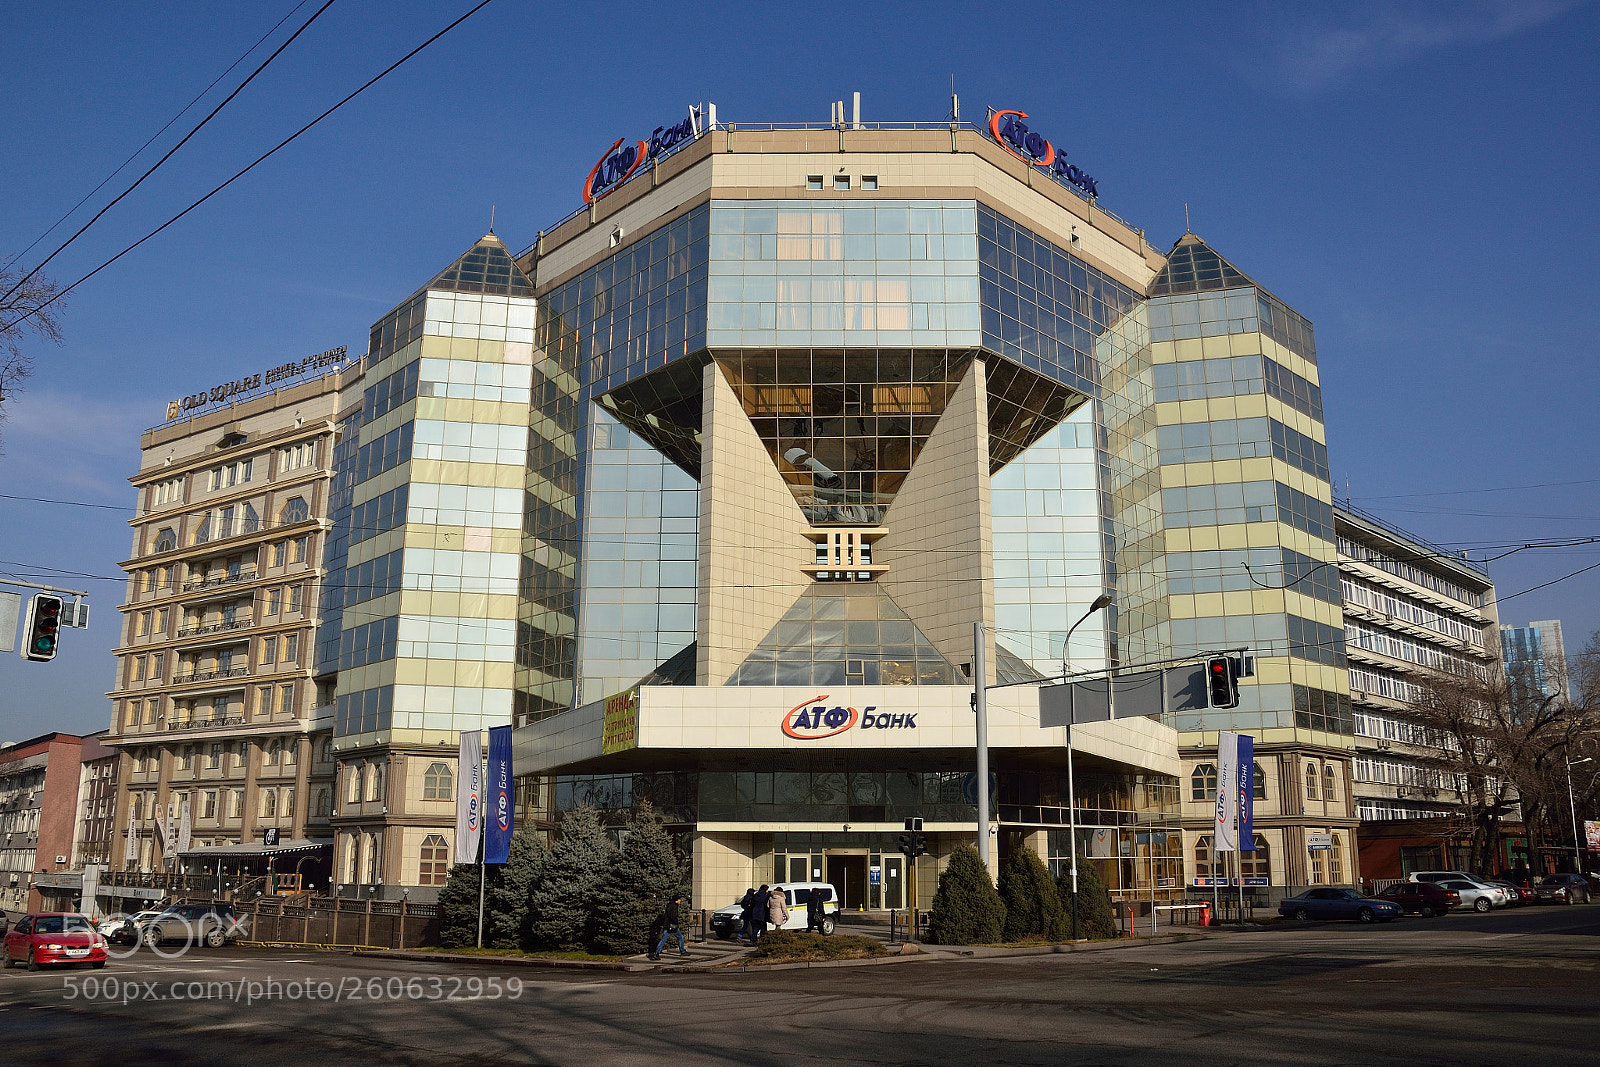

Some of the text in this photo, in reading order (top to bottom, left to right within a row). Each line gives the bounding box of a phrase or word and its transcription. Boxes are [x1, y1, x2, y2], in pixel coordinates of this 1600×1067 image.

[591, 146, 638, 194] АТФ
[999, 115, 1098, 197] АТФ Банк
[312, 353, 347, 369] CENTER
[182, 373, 262, 410] OLD SQUARE
[792, 706, 918, 729] АТФ Банк
[499, 761, 507, 825] АТФ Банк
[1240, 763, 1248, 788] Банк
